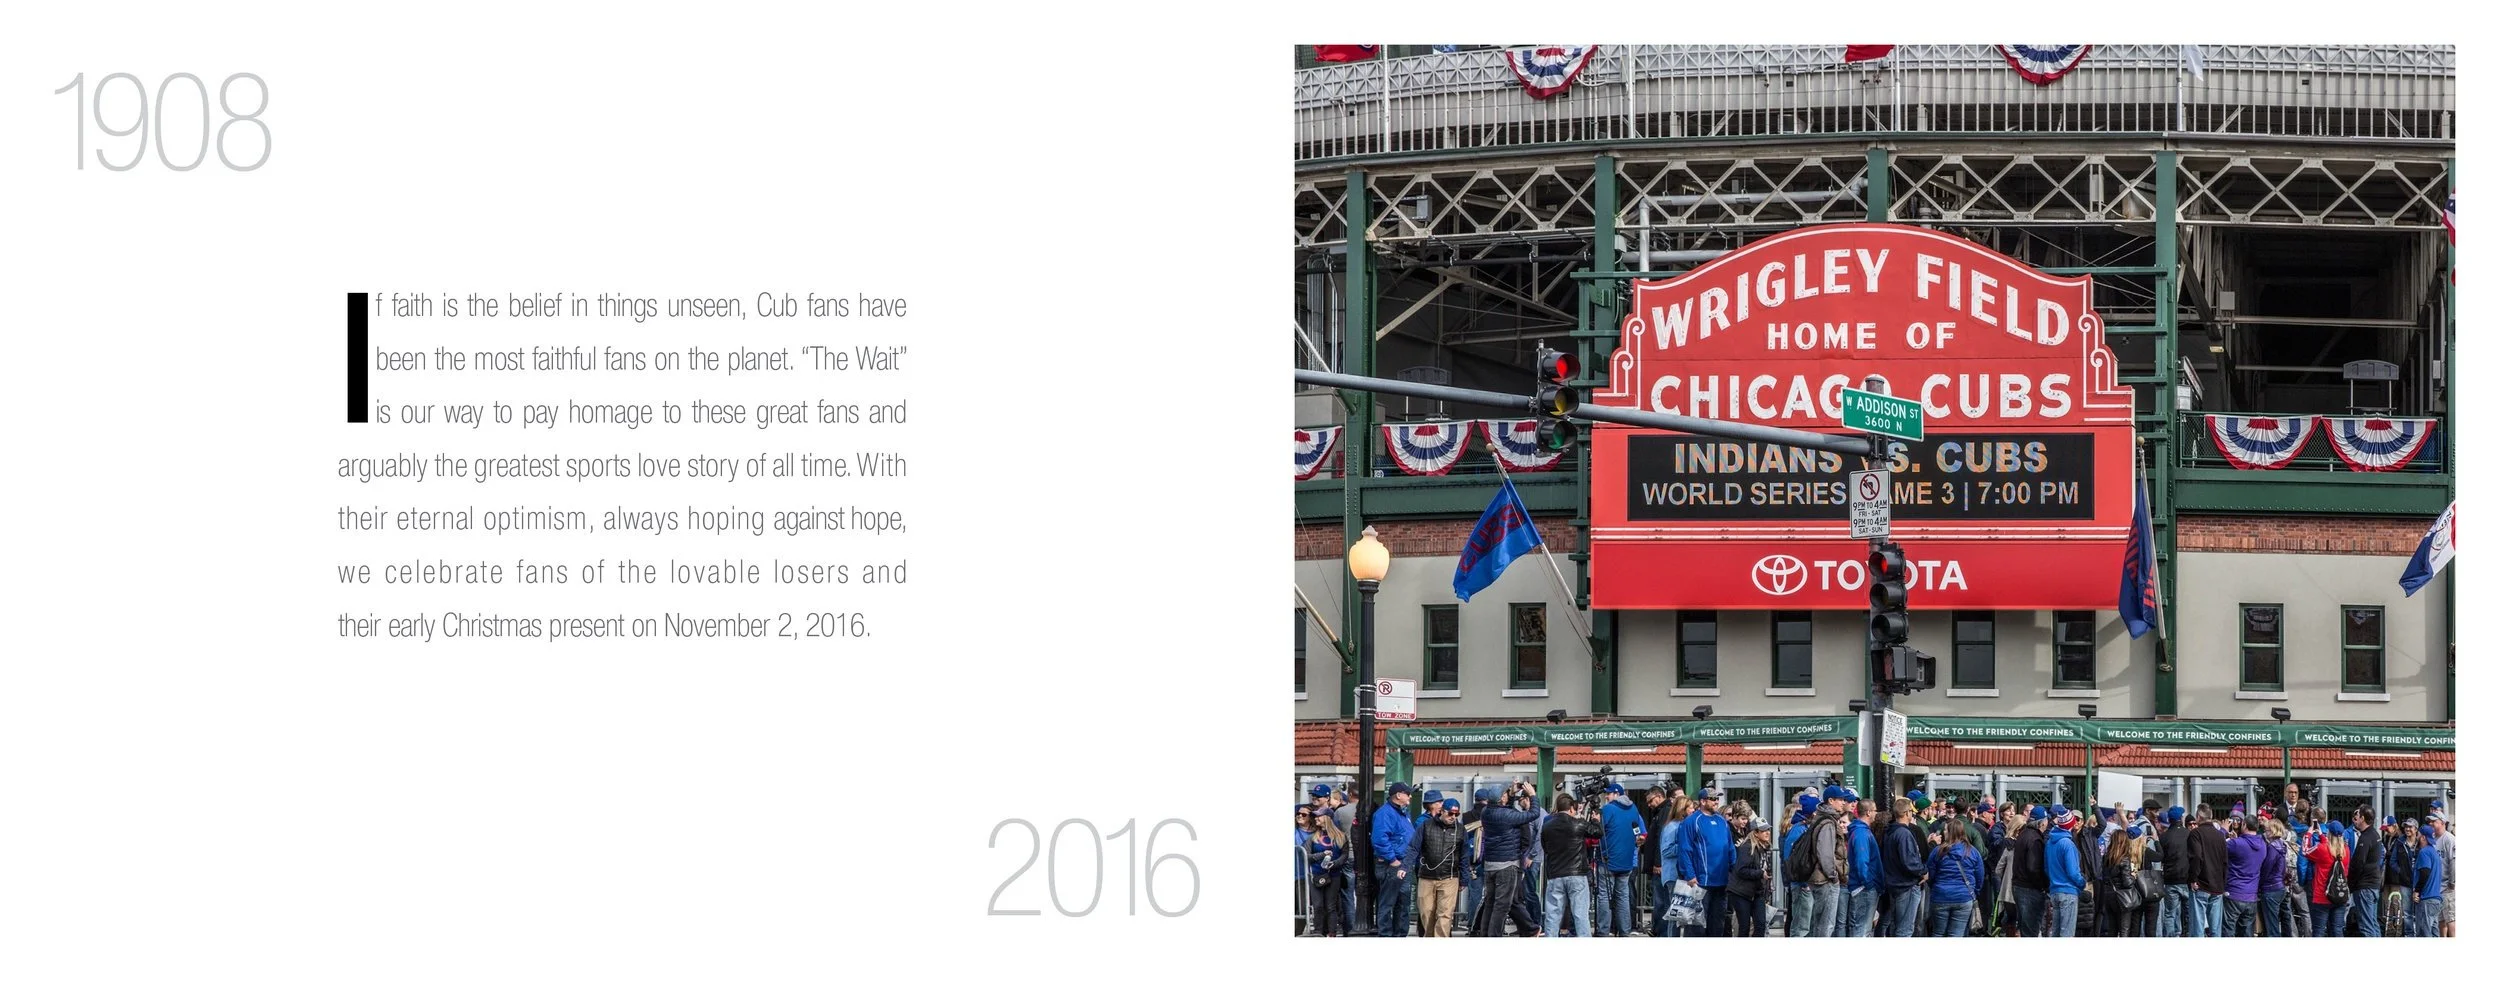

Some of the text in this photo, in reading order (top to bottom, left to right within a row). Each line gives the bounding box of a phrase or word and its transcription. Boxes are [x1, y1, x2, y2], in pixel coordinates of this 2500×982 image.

[1652, 249, 2069, 350] WRIGLEY FIELD
[1768, 322, 1956, 349] HOME OF
[1921, 374, 2071, 418] CUBS
[1846, 395, 1919, 420] W ADDISON ST
[1864, 415, 1903, 432] 3600 N
[1675, 443, 1843, 474] INDIANS
[1936, 441, 2048, 473] CUBS
[1642, 482, 1743, 505] WORLD
[1750, 482, 1847, 505] SERIES
[1889, 481, 1933, 505] ME
[1941, 482, 1955, 505] 3
[1978, 482, 2031, 505] 7:00
[2040, 482, 2079, 505] PM
[1867, 501, 1873, 509] TO
[1459, 503, 1524, 572] CUBS
[1814, 559, 1968, 591] TOTA
[1410, 735, 1440, 743] WELCOME
[1465, 734, 1494, 742] FRIENDLY
[1495, 733, 1527, 741] CONFINES
[1609, 731, 1640, 739] FRIENDLY
[1641, 730, 1675, 738] CONFINES
[1700, 724, 1832, 736] WELCOME TO THE FRIENDLY CONFINES
[1906, 726, 2074, 737] WELCOME TO THE FRIENDLY CONFINES
[2107, 730, 2272, 741] WELCOME TO THE FRIENDLY CONFINES
[2304, 734, 2347, 742] WELCOME
[2349, 735, 2361, 743] TO
[2363, 735, 2380, 743] THE
[2381, 736, 2422, 744] FRIENDLY
